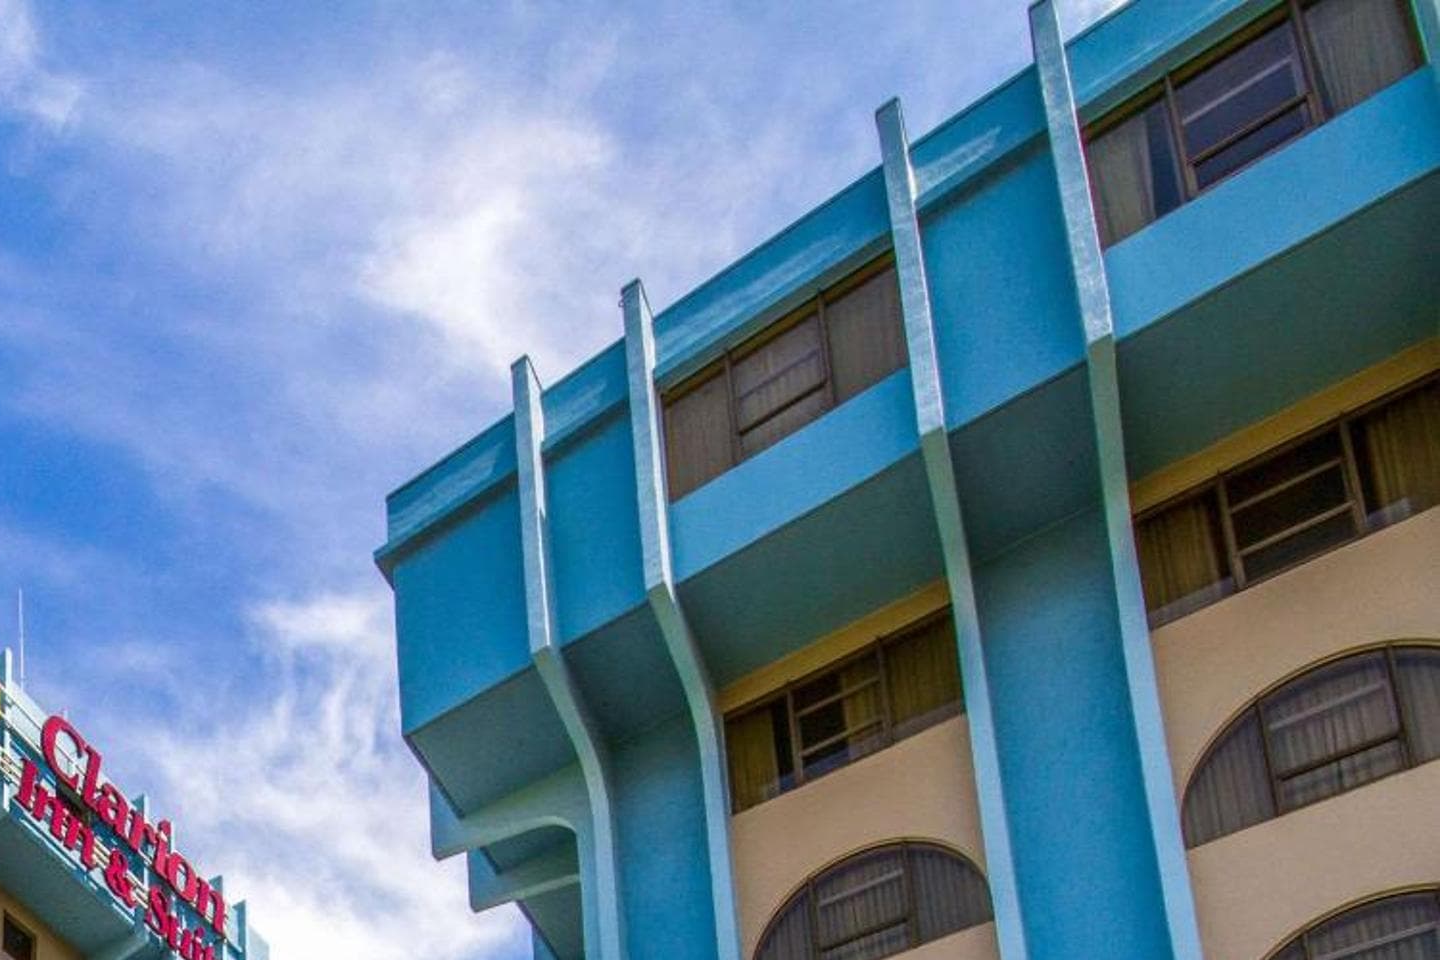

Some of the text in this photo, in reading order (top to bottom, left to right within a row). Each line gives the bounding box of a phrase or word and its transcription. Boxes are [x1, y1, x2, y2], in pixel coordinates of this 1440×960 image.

[13, 758, 95, 870] Inn
[103, 848, 135, 909] &
[41, 715, 225, 938] Clarion
